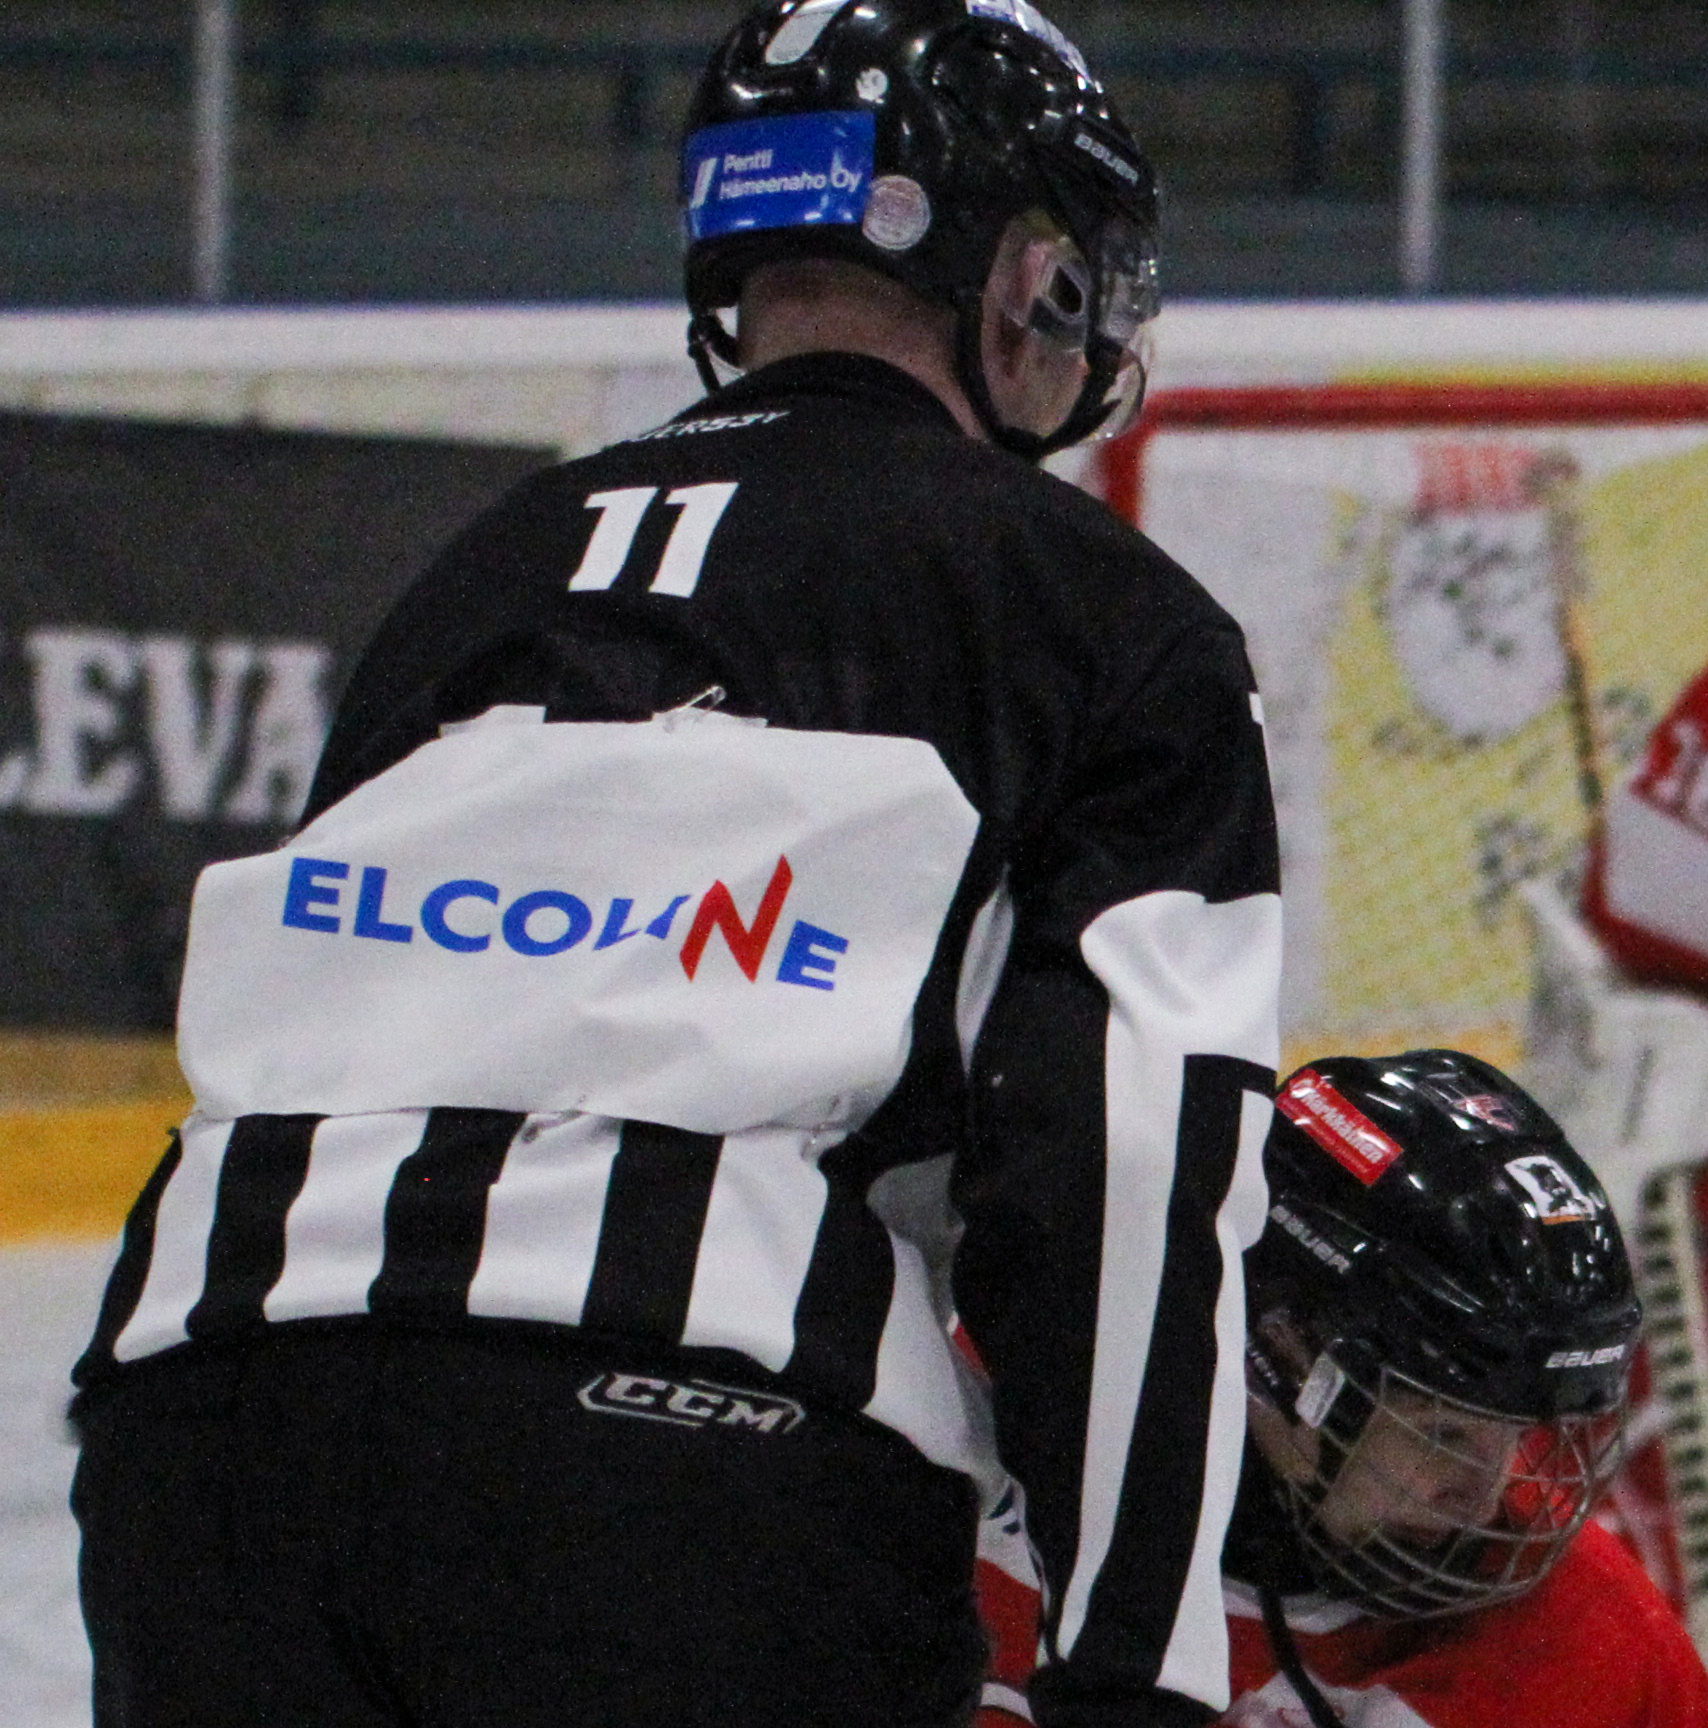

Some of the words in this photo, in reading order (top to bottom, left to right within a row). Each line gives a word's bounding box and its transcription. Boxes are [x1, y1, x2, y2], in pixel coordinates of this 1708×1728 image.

[724, 149, 773, 173] Pentti
[568, 482, 739, 598] 11
[0, 628, 330, 823] EVA
[1545, 1344, 1627, 1370] BAUER
[604, 1373, 786, 1433] CCM
